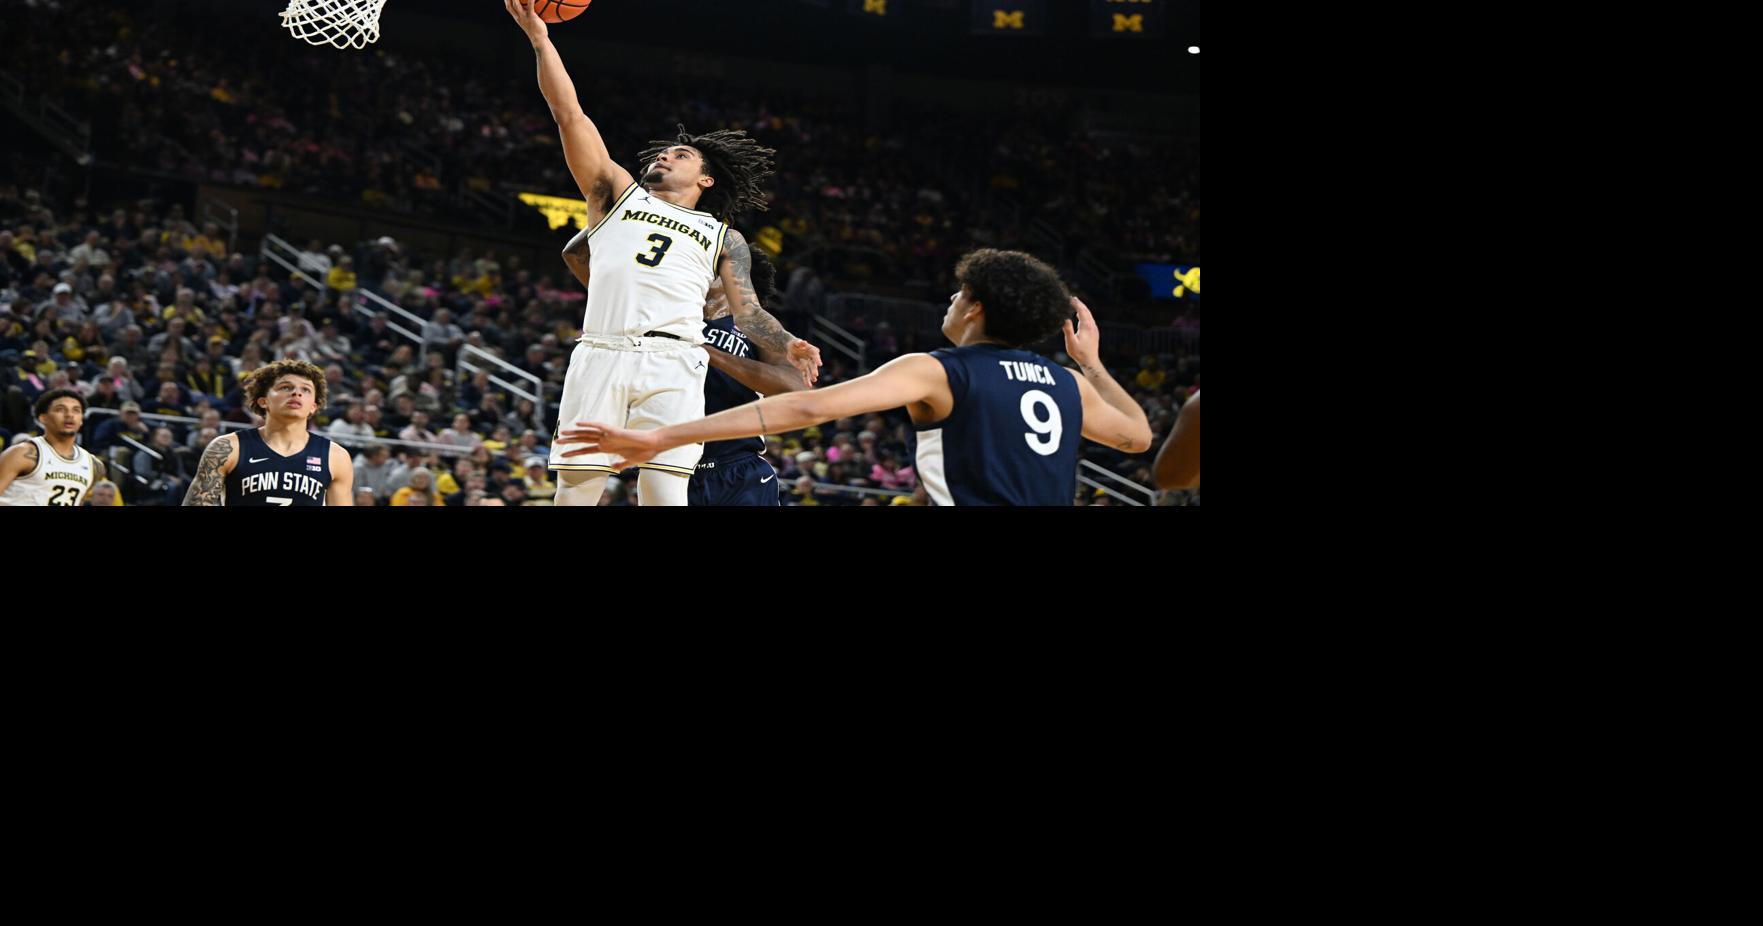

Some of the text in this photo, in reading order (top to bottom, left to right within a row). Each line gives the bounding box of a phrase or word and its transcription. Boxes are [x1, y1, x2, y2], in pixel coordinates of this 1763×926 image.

[993, 11, 1023, 28] M
[1113, 13, 1142, 32] M
[621, 209, 712, 252] MICHIGAN
[635, 232, 673, 268] 3
[705, 328, 749, 358] STATE
[999, 360, 1056, 386] TUNCA
[1020, 389, 1062, 456] 9
[45, 472, 88, 487] MICHIGAN
[241, 471, 323, 500] PENN STATE
[48, 485, 80, 506] 23
